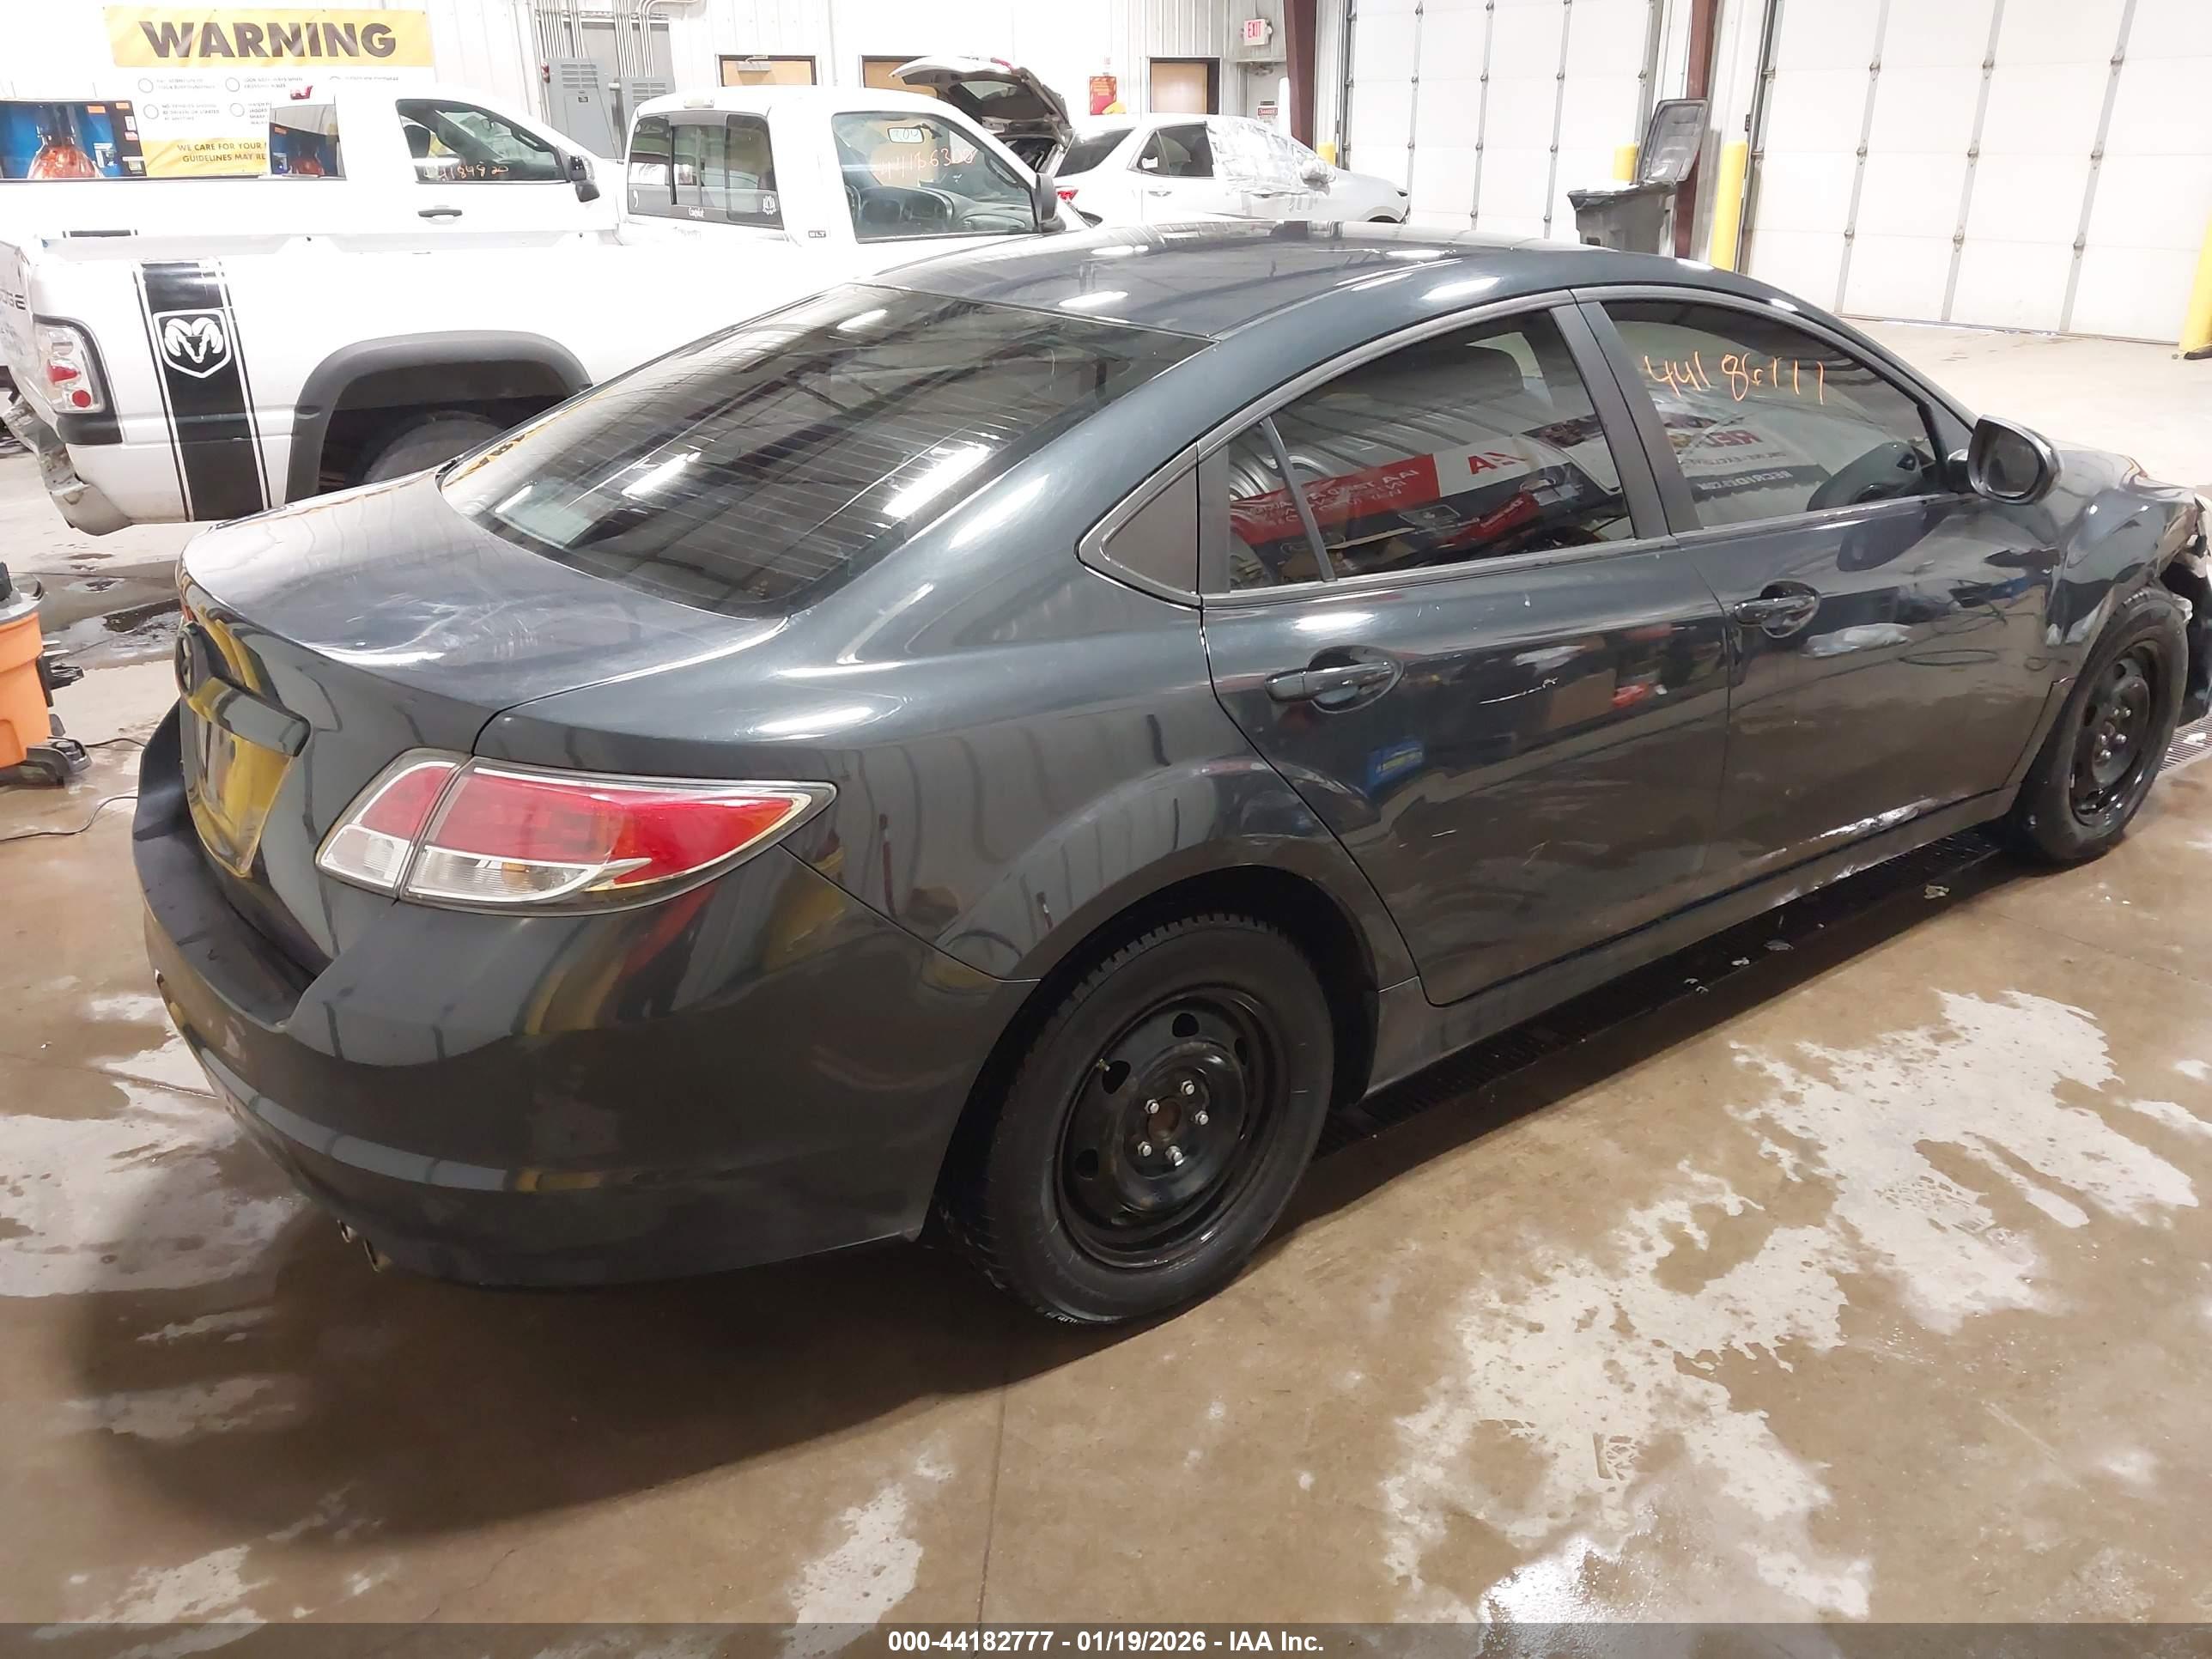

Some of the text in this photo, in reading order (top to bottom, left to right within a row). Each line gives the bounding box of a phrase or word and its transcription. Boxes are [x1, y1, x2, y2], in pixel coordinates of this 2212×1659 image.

[1248, 21, 1261, 39] EXIT
[138, 21, 396, 58] WARNING
[182, 154, 232, 162] GUIDELINES
